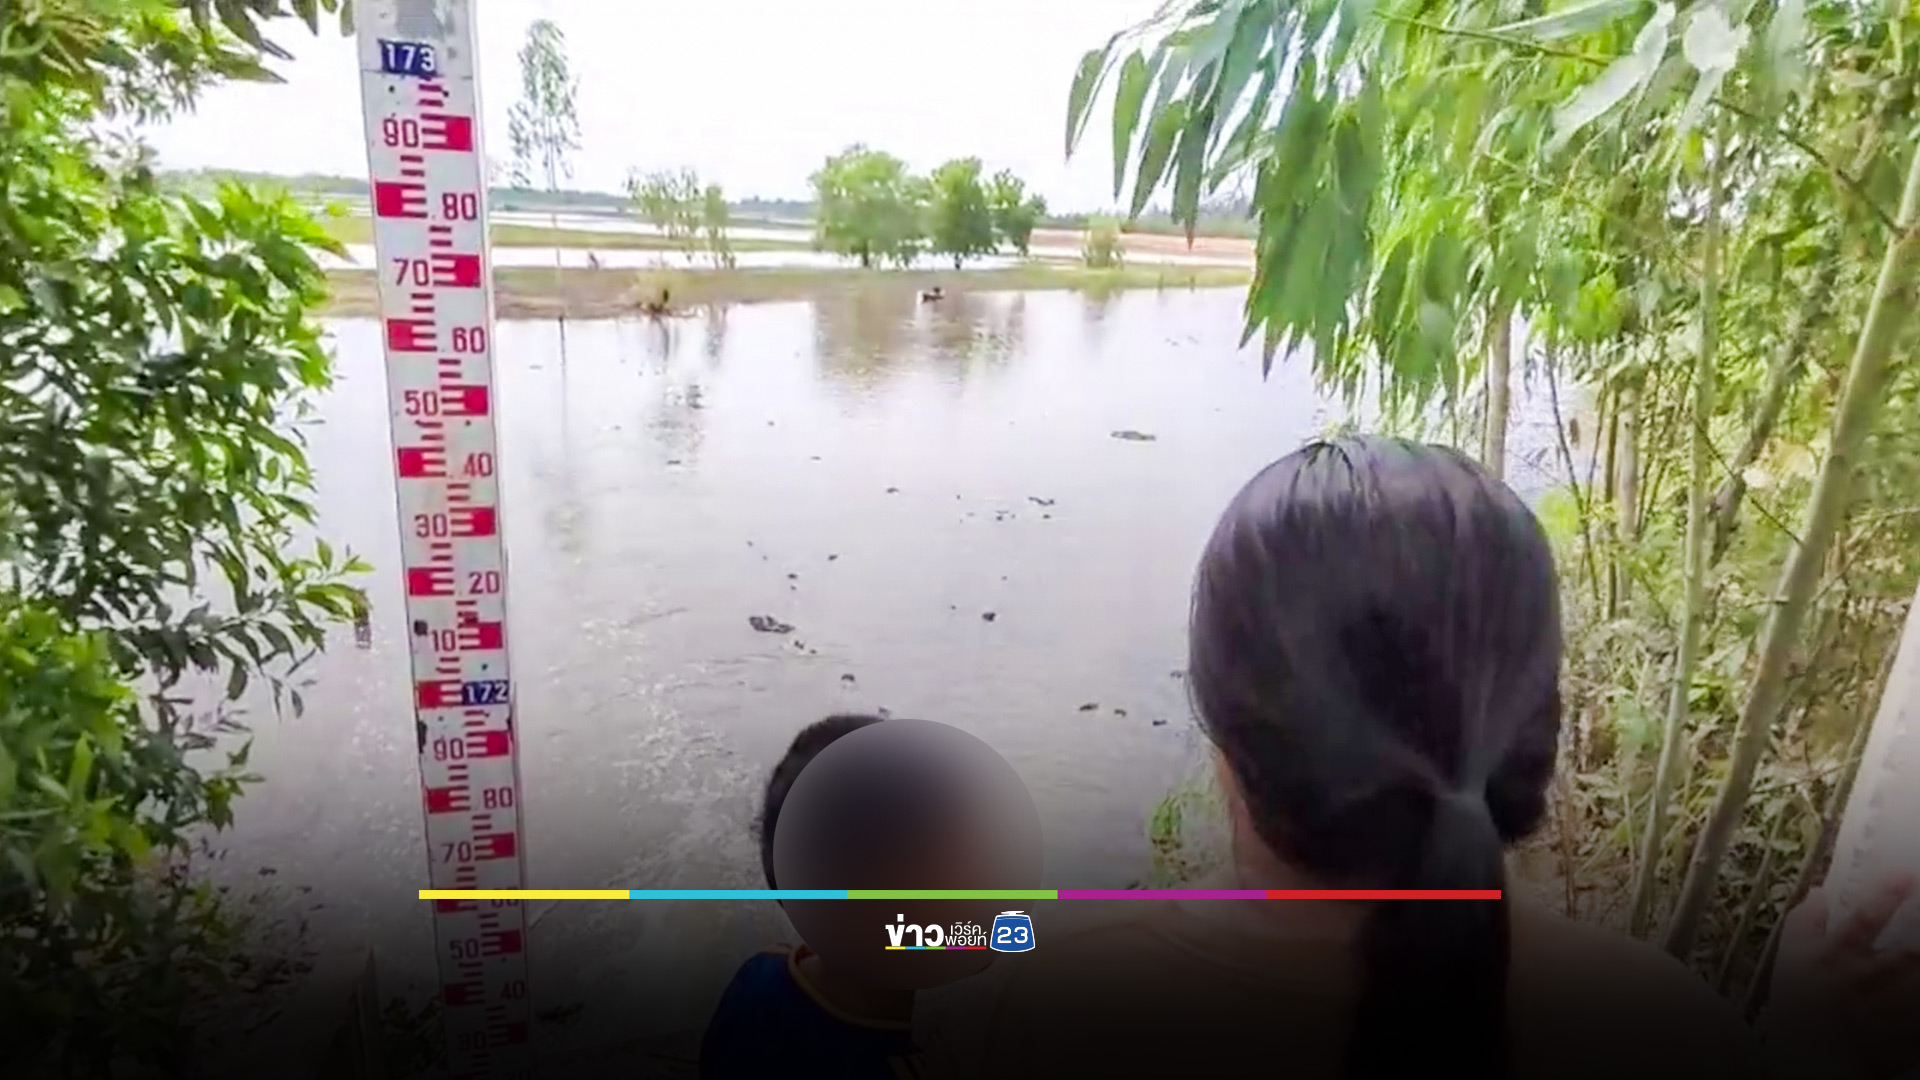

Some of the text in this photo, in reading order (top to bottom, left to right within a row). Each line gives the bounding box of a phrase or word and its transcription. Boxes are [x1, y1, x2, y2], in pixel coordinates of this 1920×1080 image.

[386, 43, 435, 71] 173
[383, 118, 419, 148] 90
[442, 192, 477, 221] 80
[393, 258, 429, 286] 70
[452, 326, 485, 353] 60
[404, 390, 438, 416] 50
[464, 452, 493, 477] 40
[414, 513, 447, 538] 30
[469, 571, 499, 594] 20
[431, 629, 456, 652] 10
[466, 682, 508, 702] 172
[433, 738, 464, 761] 90
[483, 787, 513, 809] 80
[440, 841, 472, 863] 70
[449, 938, 478, 960] 50
[500, 980, 525, 999] 40
